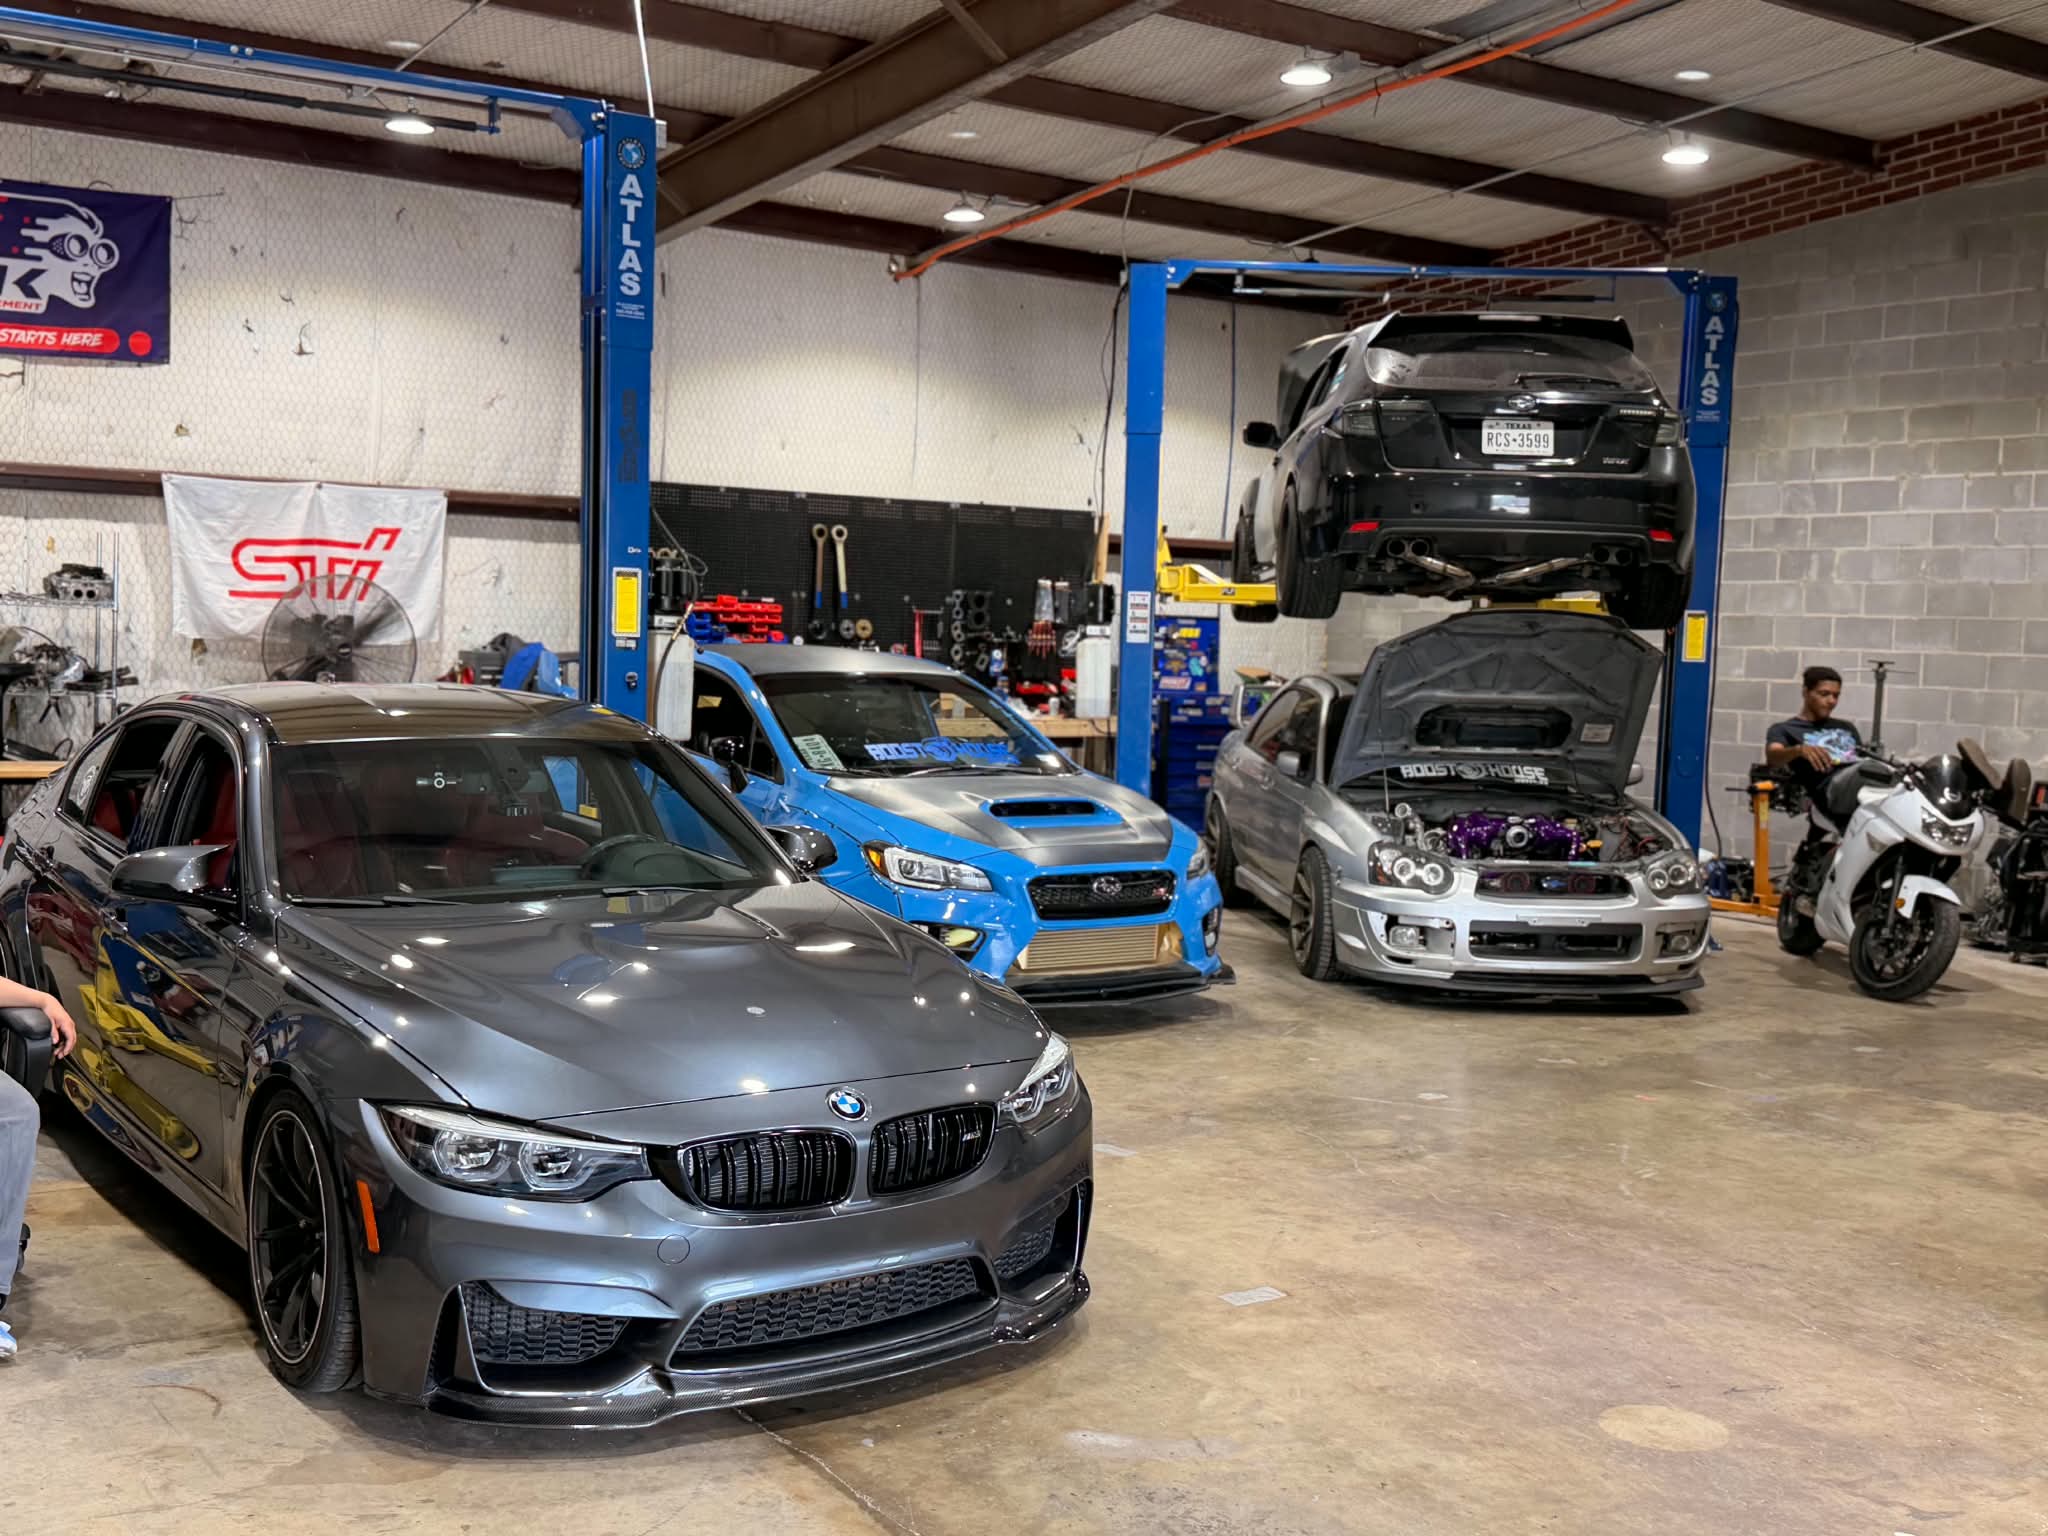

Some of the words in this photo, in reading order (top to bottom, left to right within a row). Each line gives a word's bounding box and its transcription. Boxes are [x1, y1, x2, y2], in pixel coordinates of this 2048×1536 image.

[619, 174, 643, 296] ATLAS
[0, 300, 42, 311] MENT
[0, 328, 57, 346] STARTS
[61, 332, 104, 347] HERE
[1700, 315, 1725, 406] ATLAS
[1504, 422, 1532, 430] TEXAS
[1400, 763, 1457, 779] BOOST
[1486, 764, 1545, 780] HOUSE
